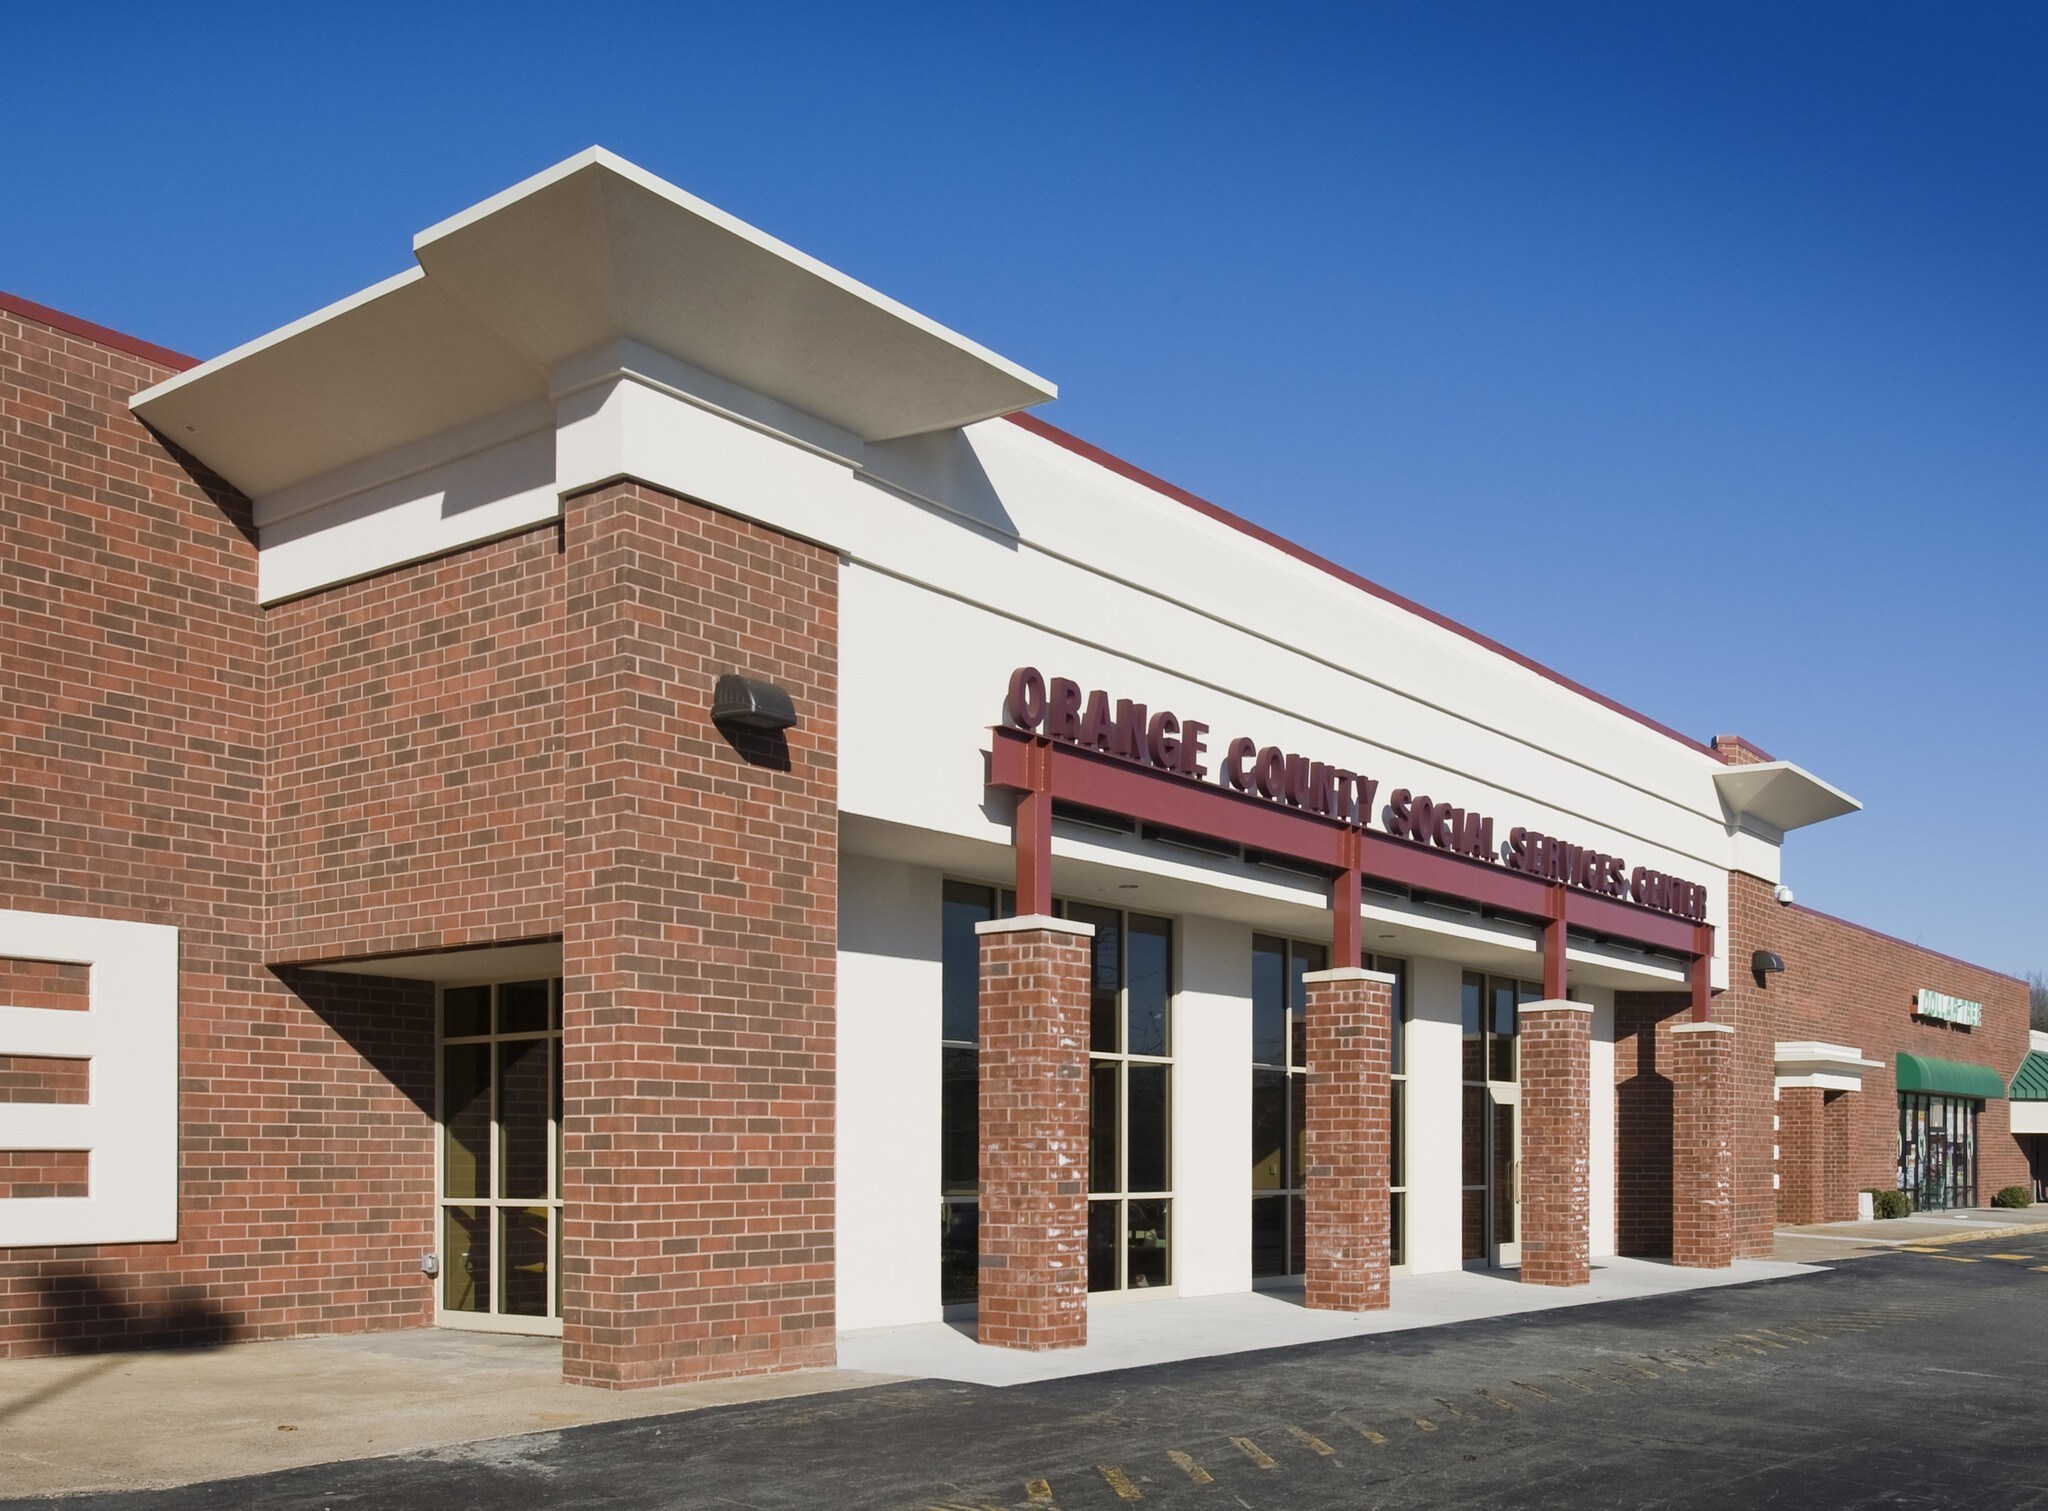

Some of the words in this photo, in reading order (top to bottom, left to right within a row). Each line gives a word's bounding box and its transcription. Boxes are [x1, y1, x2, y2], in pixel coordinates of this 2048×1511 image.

[1009, 667, 1209, 777] ORANGE
[1228, 737, 1379, 823] COUNTY
[1390, 789, 1499, 860] SOCIAL
[1509, 827, 1625, 896] SERVICES
[1631, 866, 1707, 920] CENTER
[1920, 989, 1959, 1022] DOLLAR
[1959, 1000, 1982, 1027] TREE
